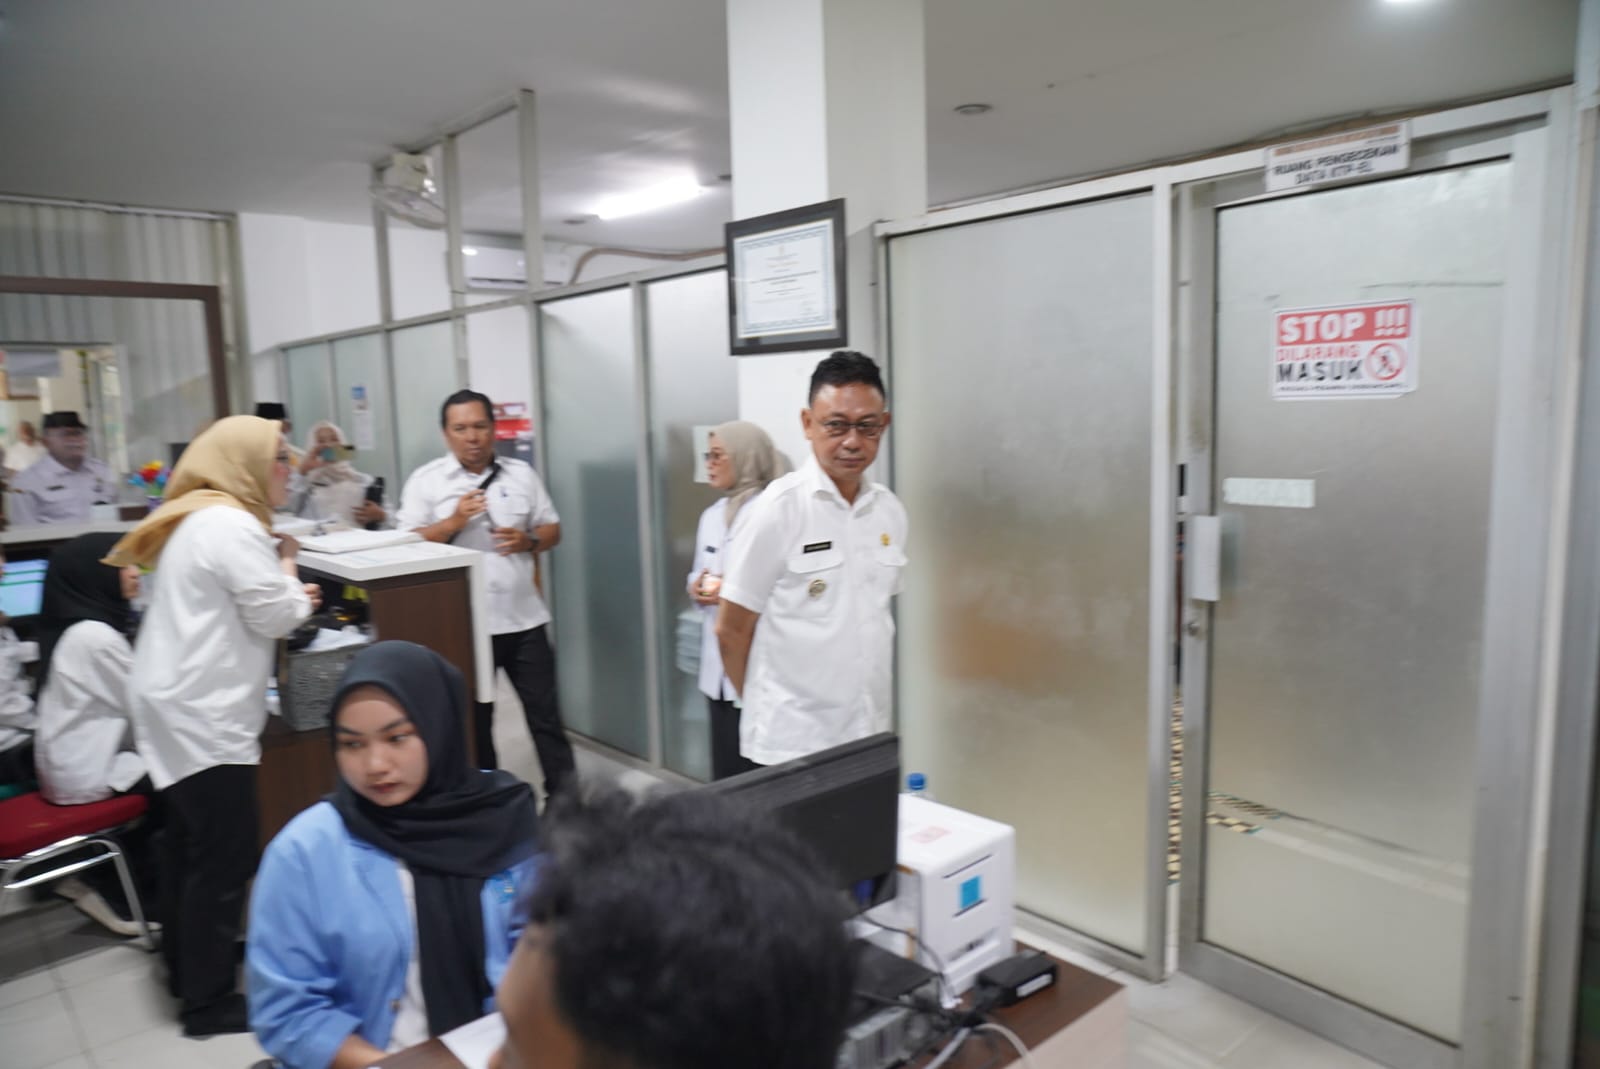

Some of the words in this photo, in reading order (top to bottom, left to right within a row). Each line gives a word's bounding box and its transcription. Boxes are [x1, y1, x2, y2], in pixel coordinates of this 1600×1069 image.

[1281, 311, 1366, 343] STOP
[1375, 307, 1407, 336] !!!
[1278, 344, 1359, 361] DILARANG
[1278, 360, 1362, 382] MASUK
